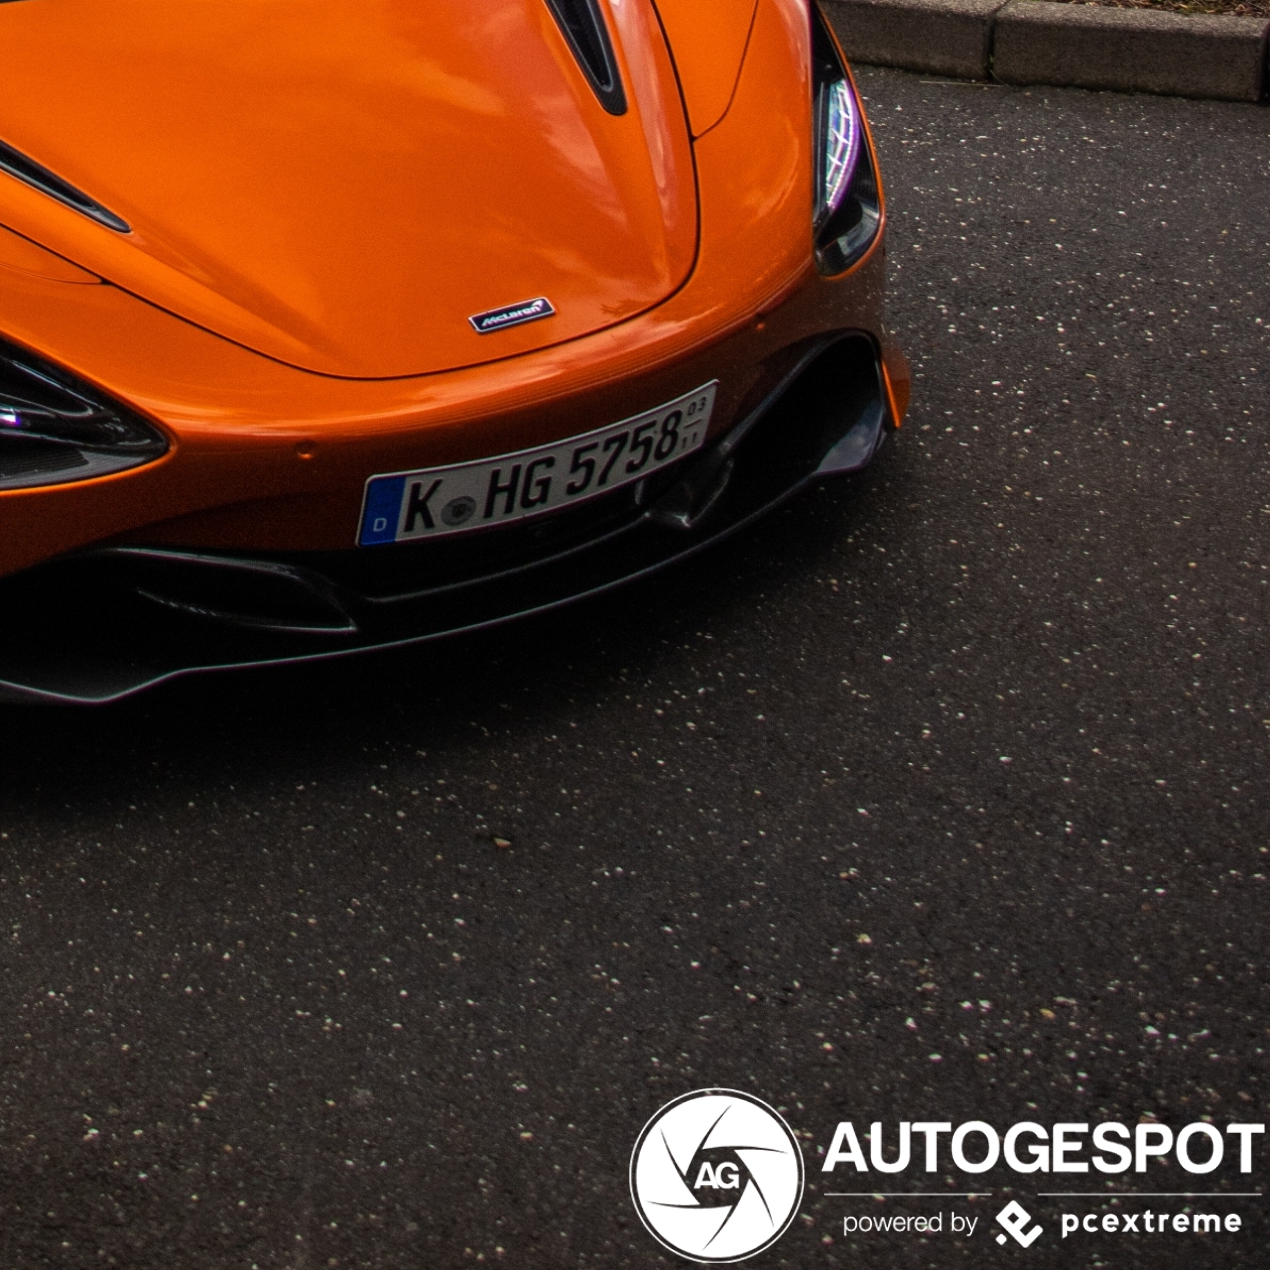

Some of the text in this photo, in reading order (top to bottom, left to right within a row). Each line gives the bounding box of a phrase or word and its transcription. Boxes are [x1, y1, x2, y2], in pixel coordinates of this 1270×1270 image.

[482, 304, 542, 328] McLaren
[372, 409, 682, 533] D K HG 5758
